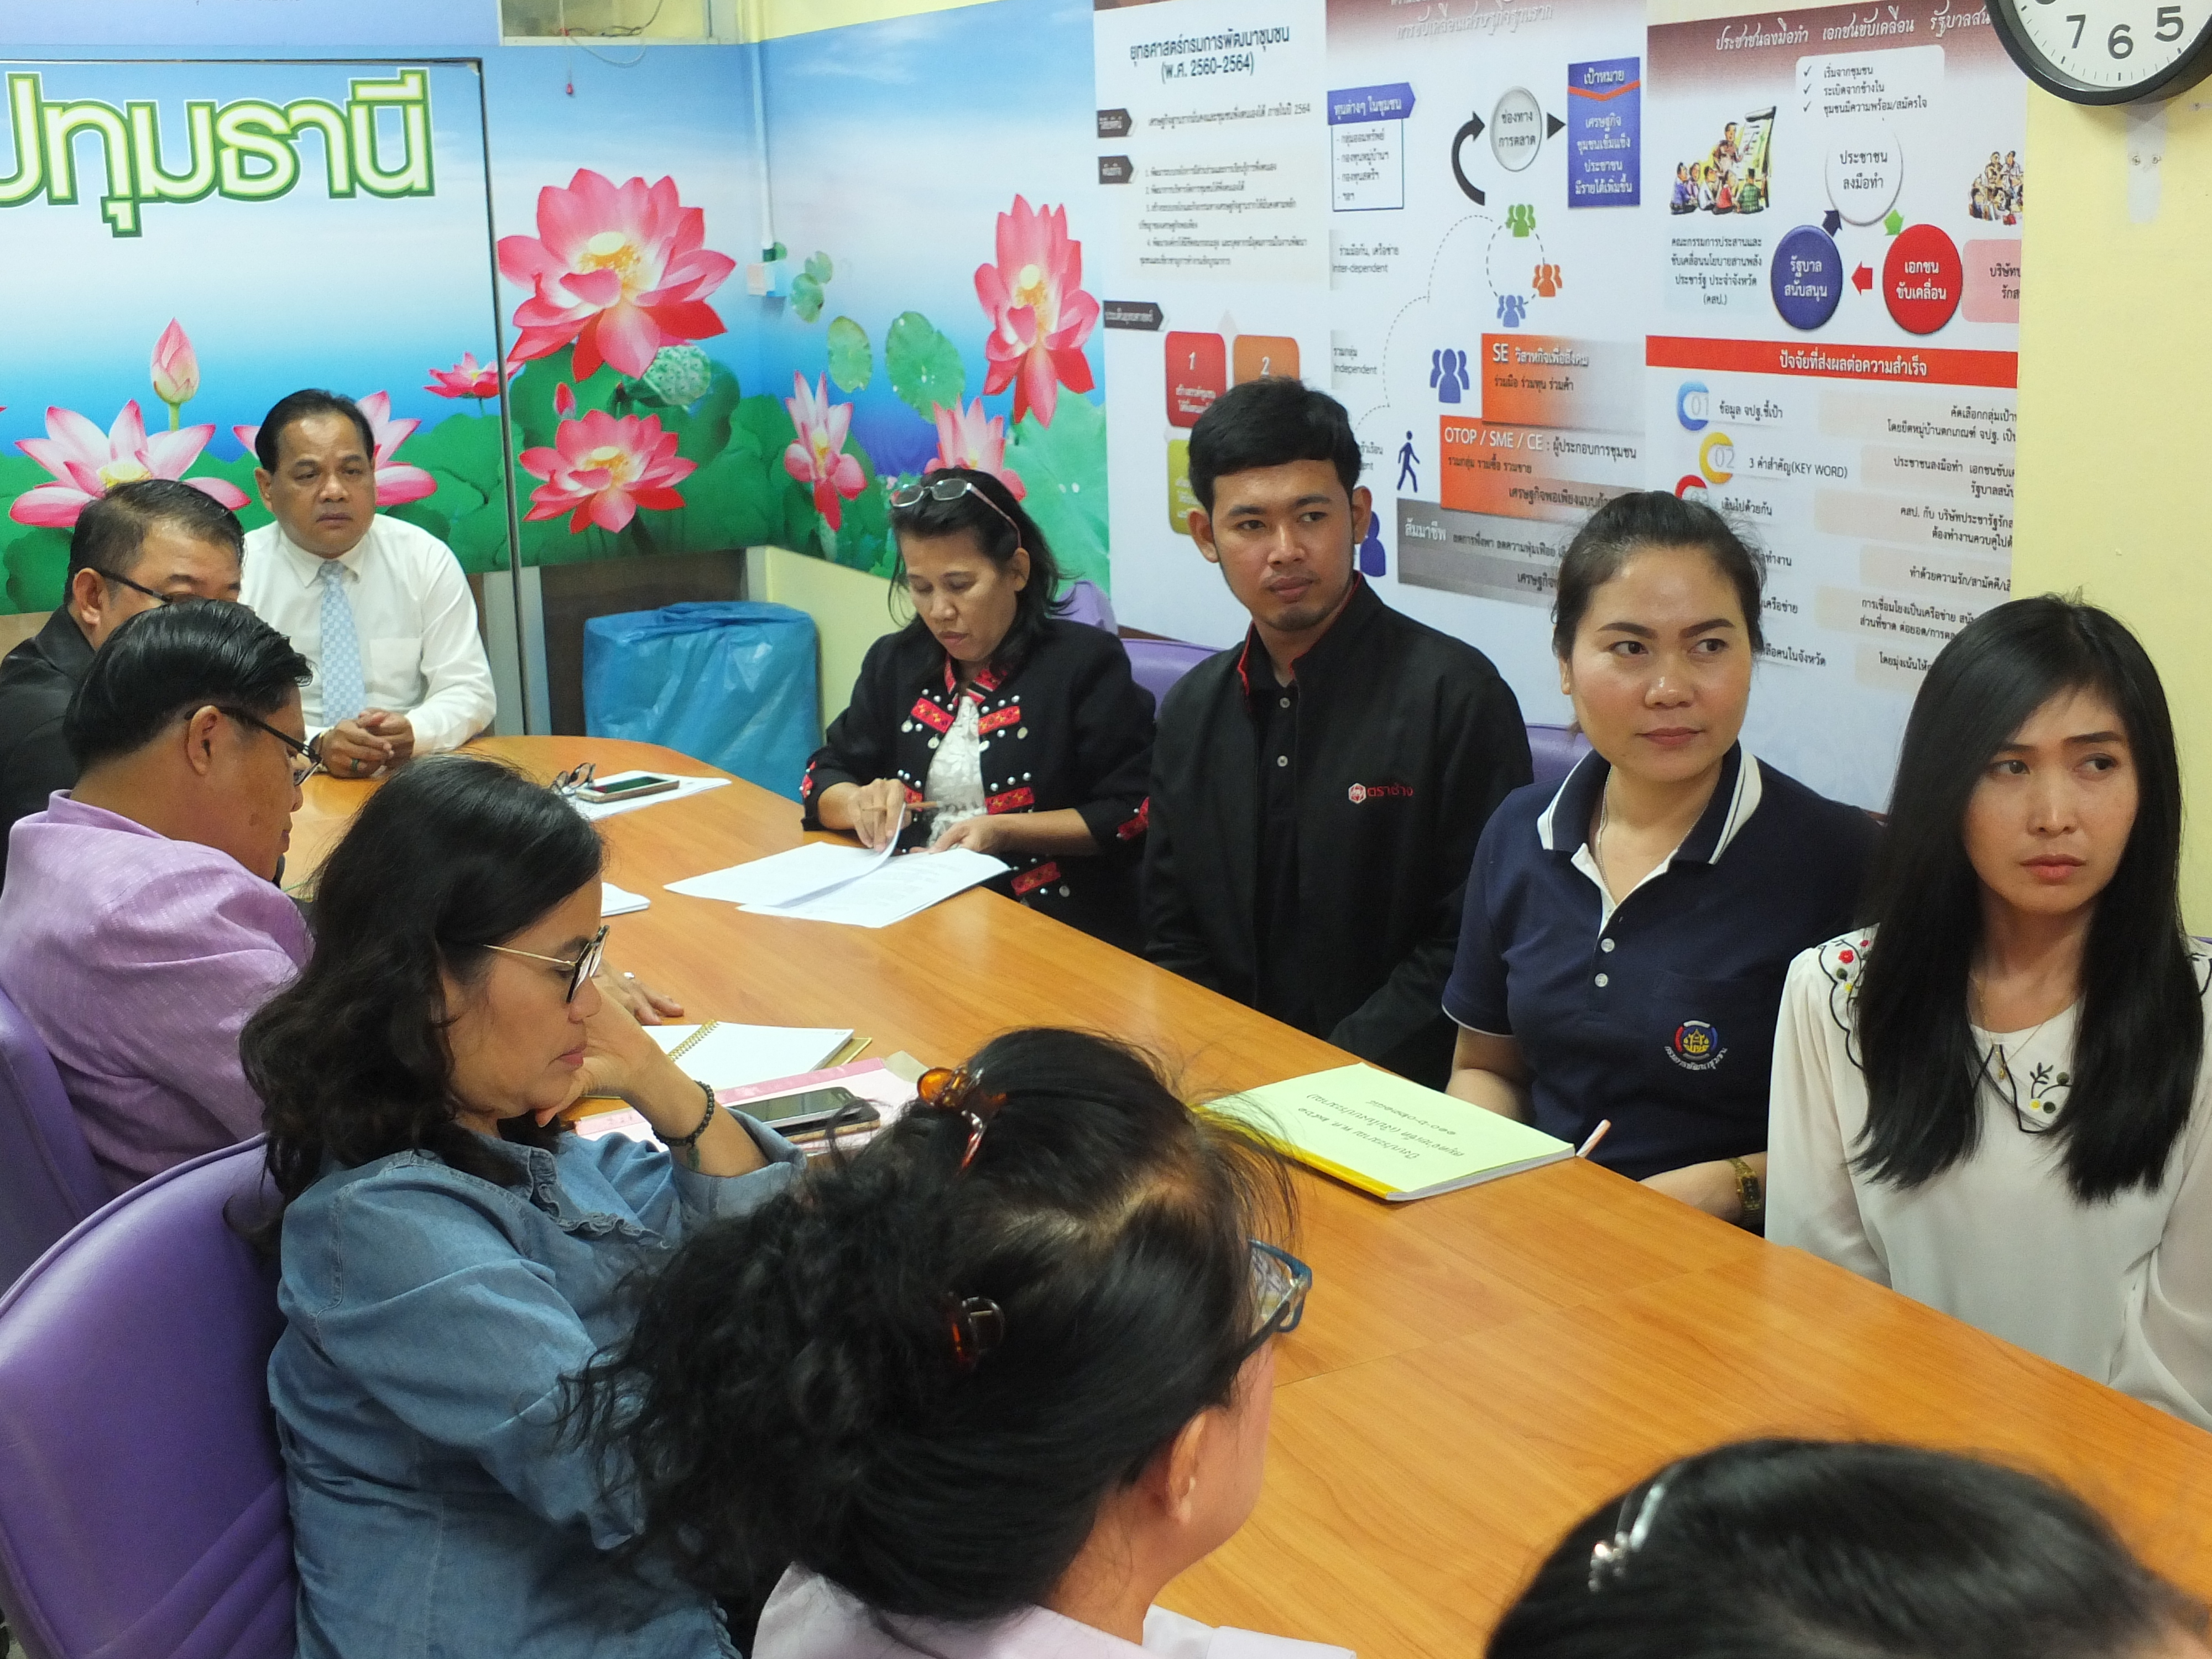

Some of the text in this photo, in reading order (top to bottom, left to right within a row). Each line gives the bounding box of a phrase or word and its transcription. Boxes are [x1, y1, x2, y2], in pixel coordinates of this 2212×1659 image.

[1716, 17, 1809, 51] ประชาชนลงมือทำ
[1823, 6, 1914, 41] เอกชนขับเคลื่อน
[2066, 14, 2086, 49] 7
[2154, 6, 2184, 42] 5
[1130, 26, 1289, 67] ยุทธศาสตร์กรมการพัฒนาชุมชน
[2107, 24, 2134, 60] 6
[1161, 51, 1254, 84] (พ.ศ. 2560-2564)
[1584, 67, 1625, 84] เป้าหมาย
[1824, 62, 1873, 80] เริ่มจากชุมชน
[1501, 109, 1532, 124] ช่องทาง
[1586, 113, 1621, 132] เศรษฐกิจ
[1499, 135, 1536, 147] การตลาด
[1584, 160, 1623, 172] ประชาชน
[1840, 150, 1887, 164] ประชาชน
[1843, 172, 1884, 190] ลงมือทำ
[1790, 255, 1822, 278] รัฐบาล
[1905, 260, 1940, 274] เอกชน
[1675, 273, 1707, 289] ประชารัฐ
[1784, 278, 1827, 302] สนับสนุน
[1896, 278, 1947, 300] ขับเคลื่อน
[1189, 352, 1196, 371] 1
[1493, 342, 1589, 367] SE วิสาหกิจเพื่อสังคม
[1780, 347, 1927, 377] ปัจจัยที่ส่งผลต่อความสำเร็จ
[1261, 356, 1270, 376] 2
[1720, 400, 1741, 420] ข้อมูล
[1444, 426, 1477, 444] OTOP
[1480, 430, 1487, 446] /
[1490, 430, 1514, 448] SME
[1517, 432, 1524, 448] /
[1527, 433, 1543, 451] CE
[1553, 436, 1637, 462] ผู้ประกอบการชุมชน
[1749, 458, 1754, 468] 3
[1814, 464, 1848, 479] WORD)
[1893, 456, 1963, 472] ประชาชนลงมือทำ
[1923, 505, 1934, 519] กับ
[1405, 518, 1446, 541] สัมมาชีพ
[1367, 782, 1414, 797] ตราช้าง
